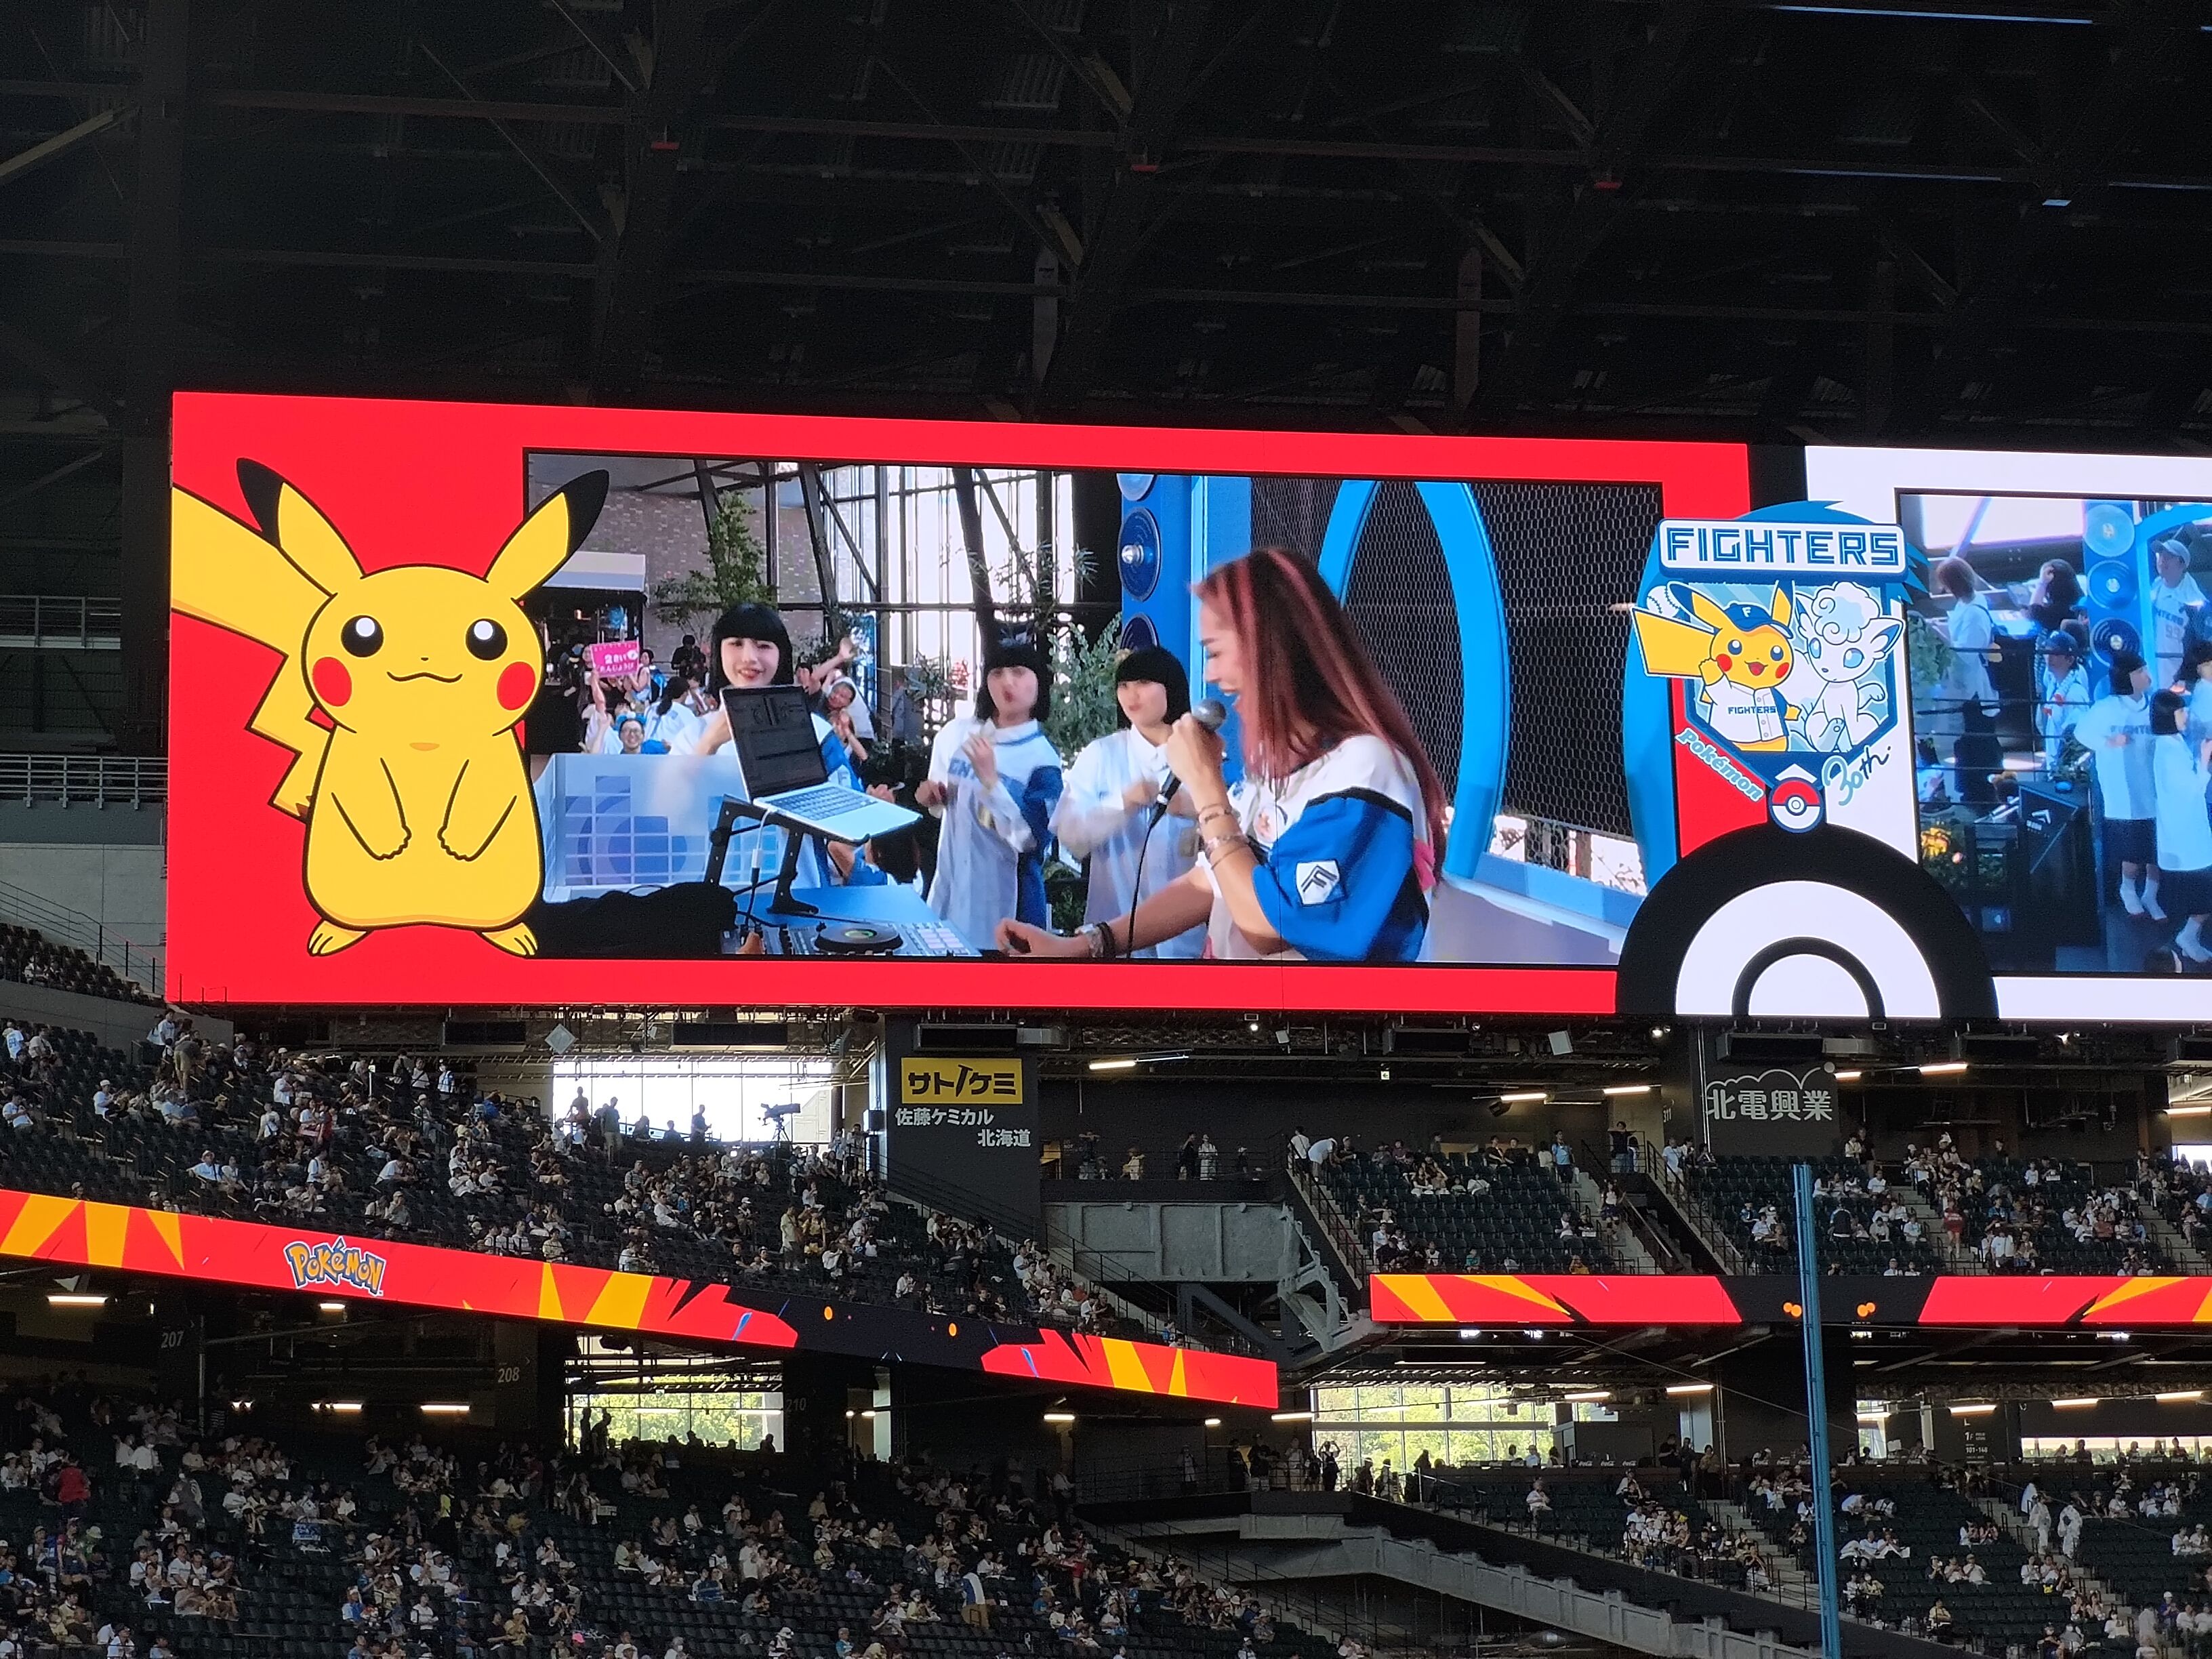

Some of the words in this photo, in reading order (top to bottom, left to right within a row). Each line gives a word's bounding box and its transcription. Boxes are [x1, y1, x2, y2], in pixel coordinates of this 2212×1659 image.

[1666, 527, 1898, 566] FIGHTERS
[1742, 607, 1751, 617] F
[1727, 706, 1776, 714] FIGHTERS
[1676, 729, 1763, 800] Pokémon
[1706, 1088, 1832, 1121] 北電興業
[895, 1107, 994, 1126] 佐藤ケミカル
[977, 1128, 1031, 1147] 北海道
[161, 1330, 184, 1348] 207
[497, 1367, 520, 1383] 208
